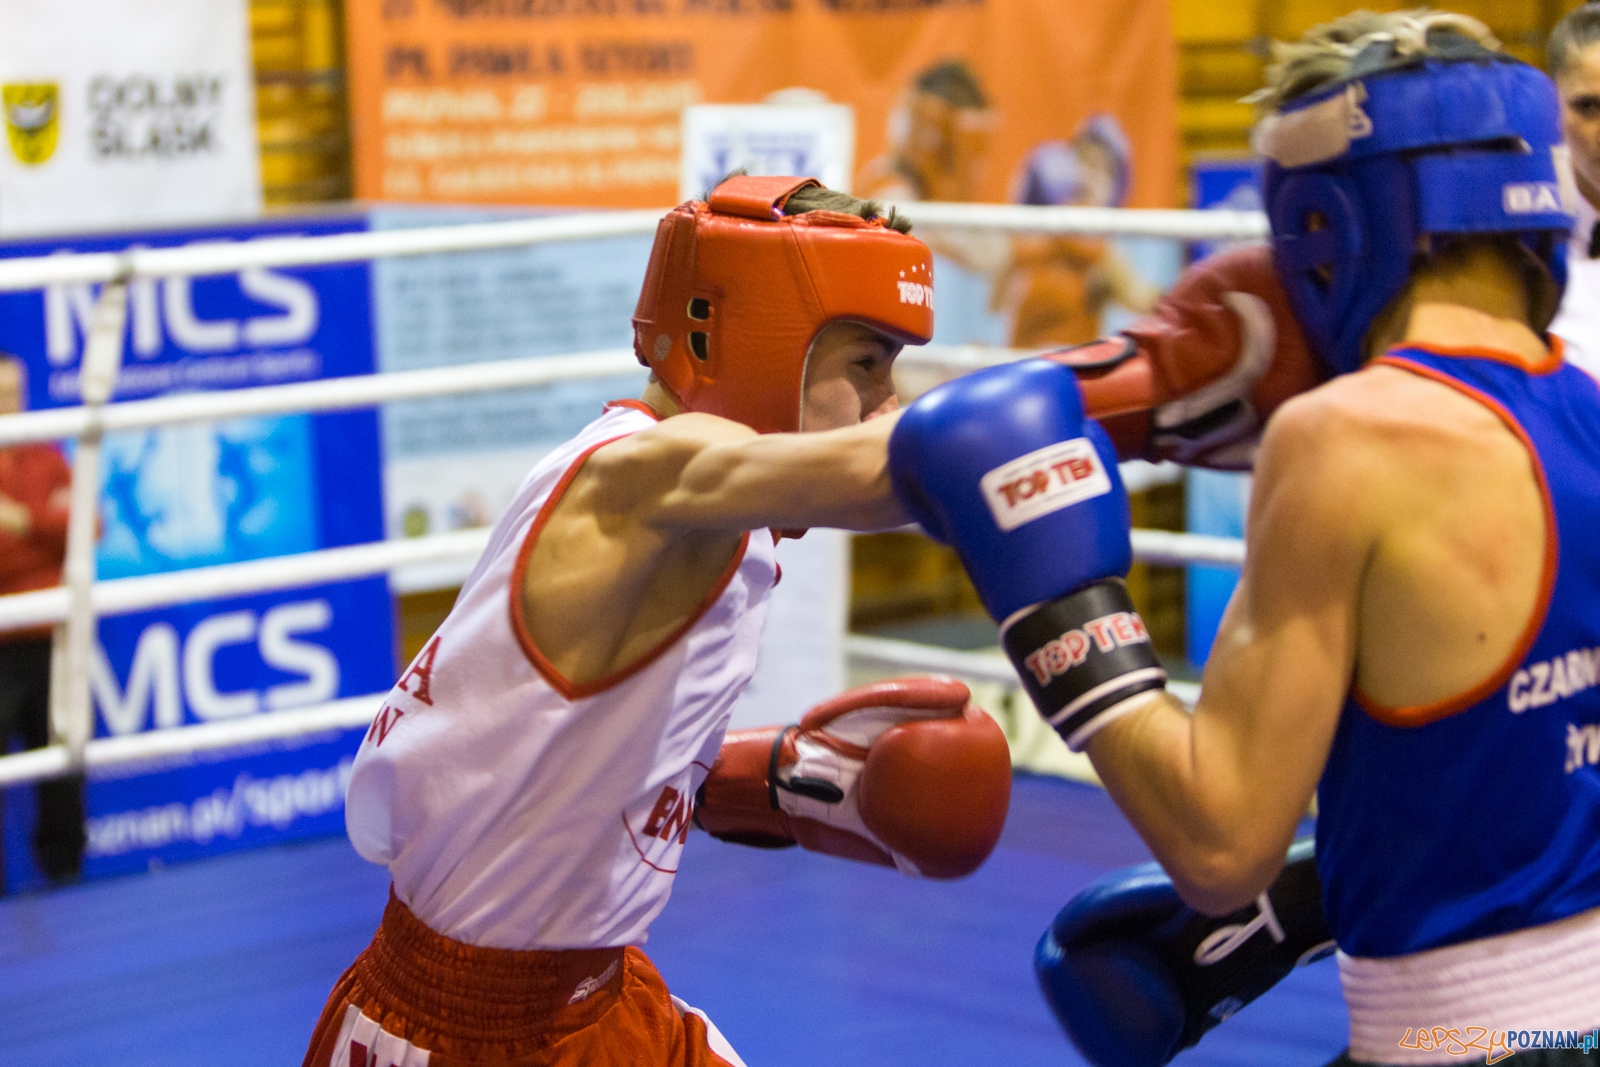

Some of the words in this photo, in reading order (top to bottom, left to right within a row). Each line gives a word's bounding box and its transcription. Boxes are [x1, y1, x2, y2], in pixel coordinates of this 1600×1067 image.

[896, 280, 924, 306] TOP
[997, 469, 1051, 508] TOP
[88, 598, 342, 740] MCS
[1024, 629, 1091, 687] TOP
